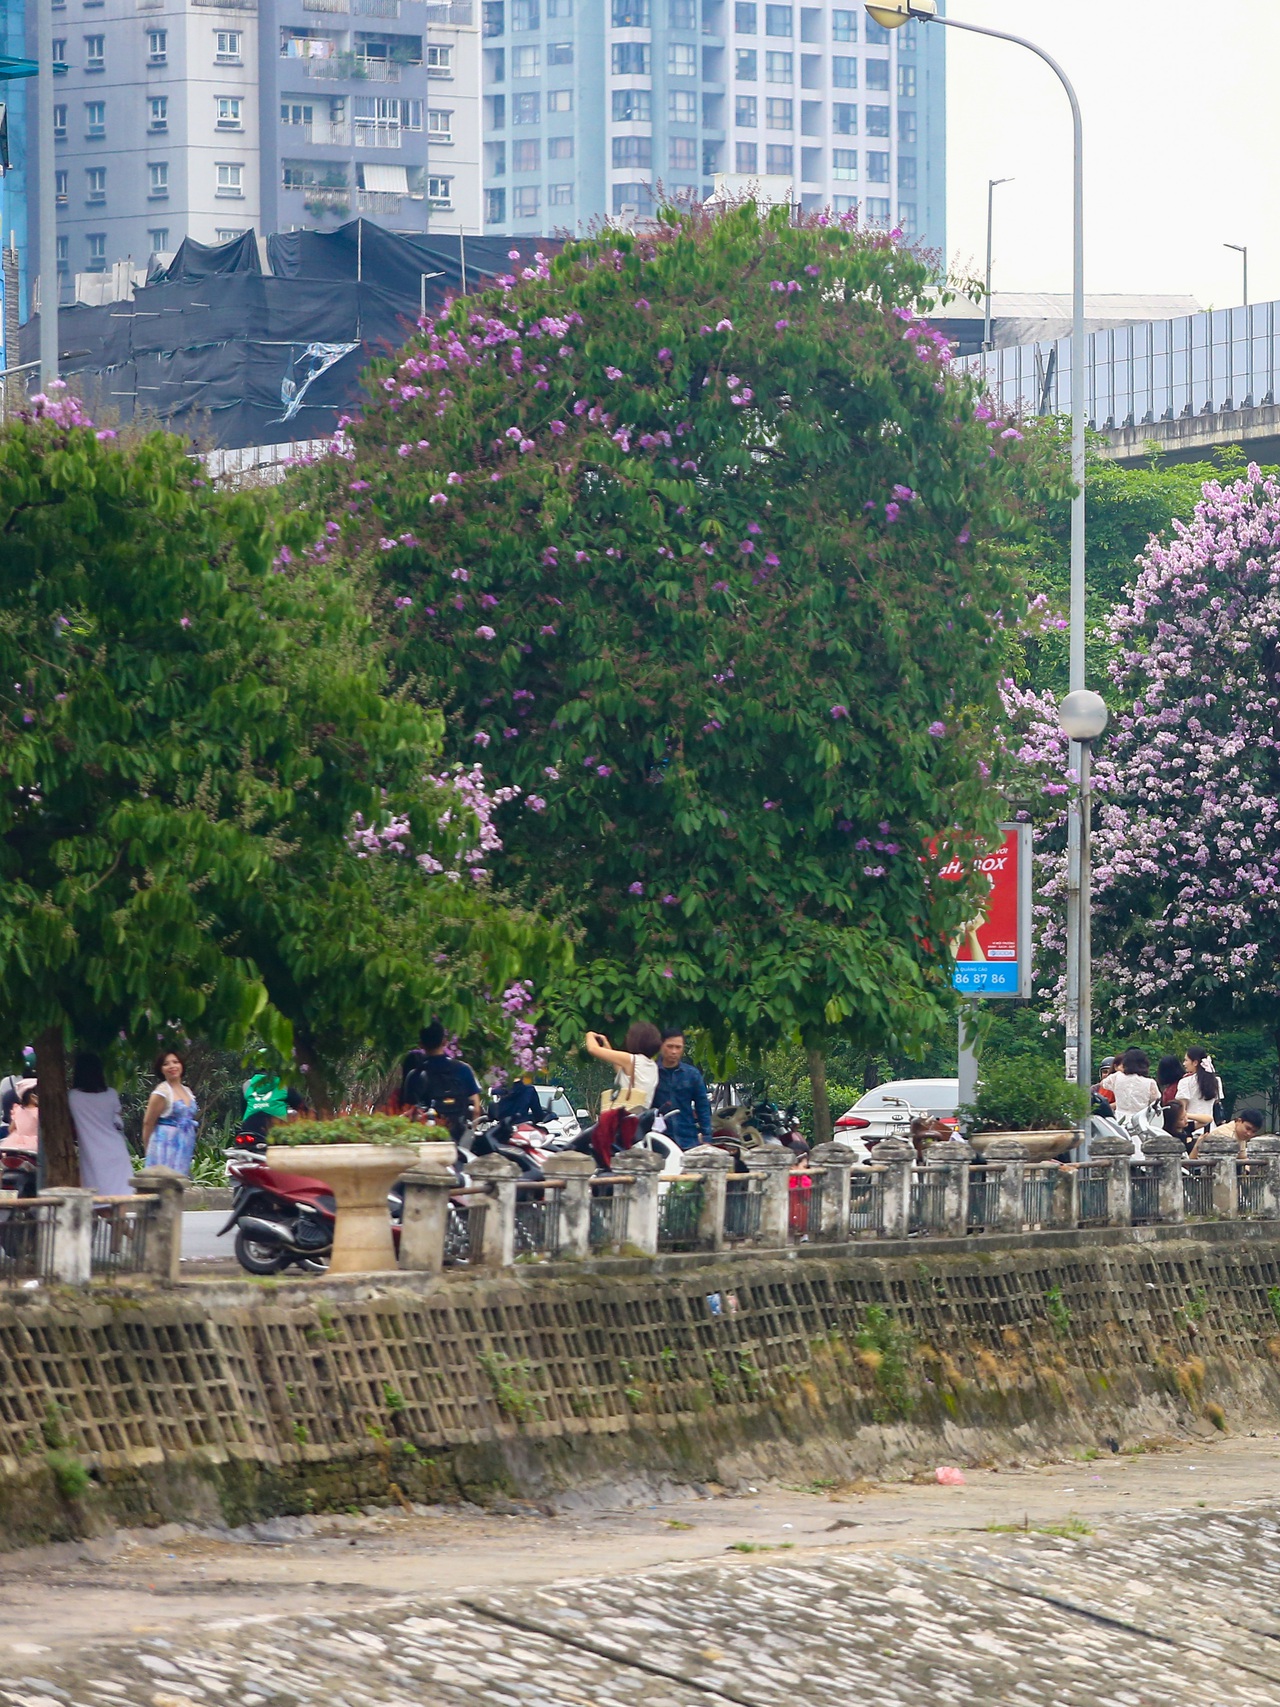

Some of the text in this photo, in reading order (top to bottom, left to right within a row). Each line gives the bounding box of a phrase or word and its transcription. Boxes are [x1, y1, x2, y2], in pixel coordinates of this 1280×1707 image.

[955, 973, 1006, 984] 86 87 86
